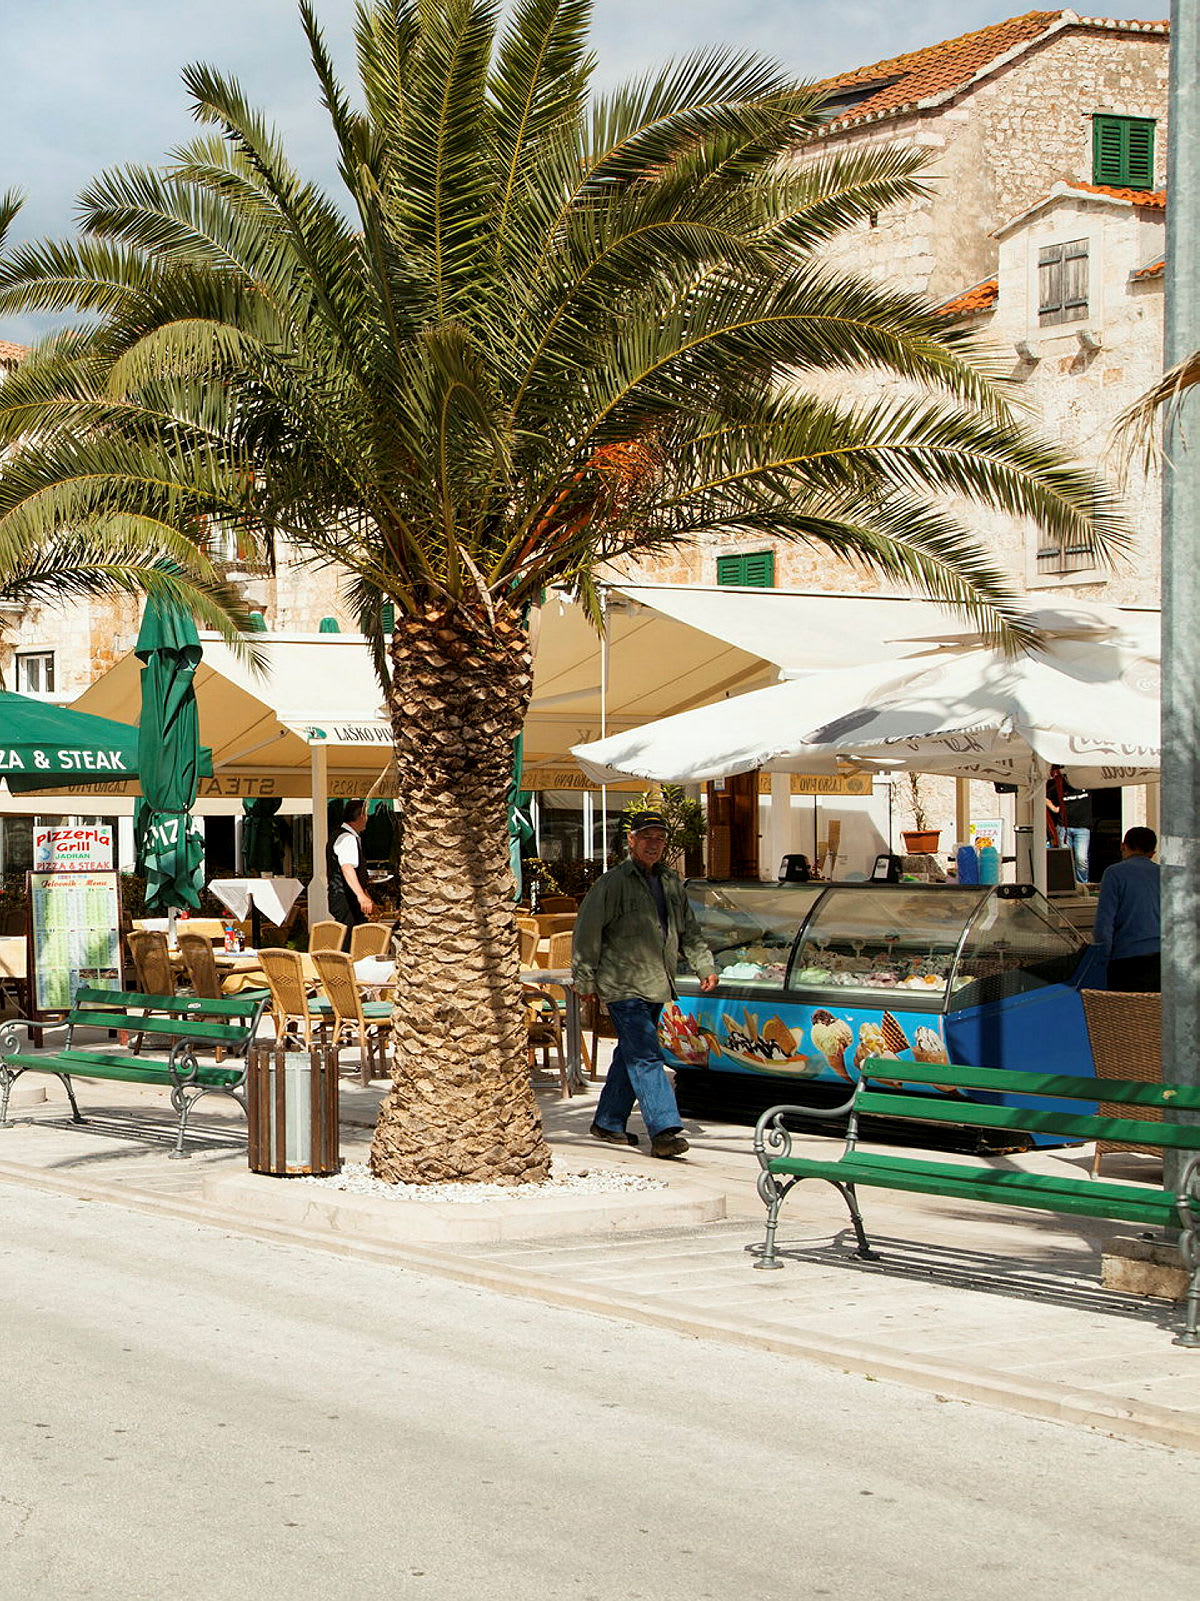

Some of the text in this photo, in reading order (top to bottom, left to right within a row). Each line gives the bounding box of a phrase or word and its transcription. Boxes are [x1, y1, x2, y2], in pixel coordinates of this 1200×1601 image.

[334, 724, 393, 742] LAŠKO PIV
[34, 751, 51, 769] &
[57, 750, 128, 770] STEAK
[36, 862, 66, 870] PIZZA
[79, 862, 110, 870] STEAK
